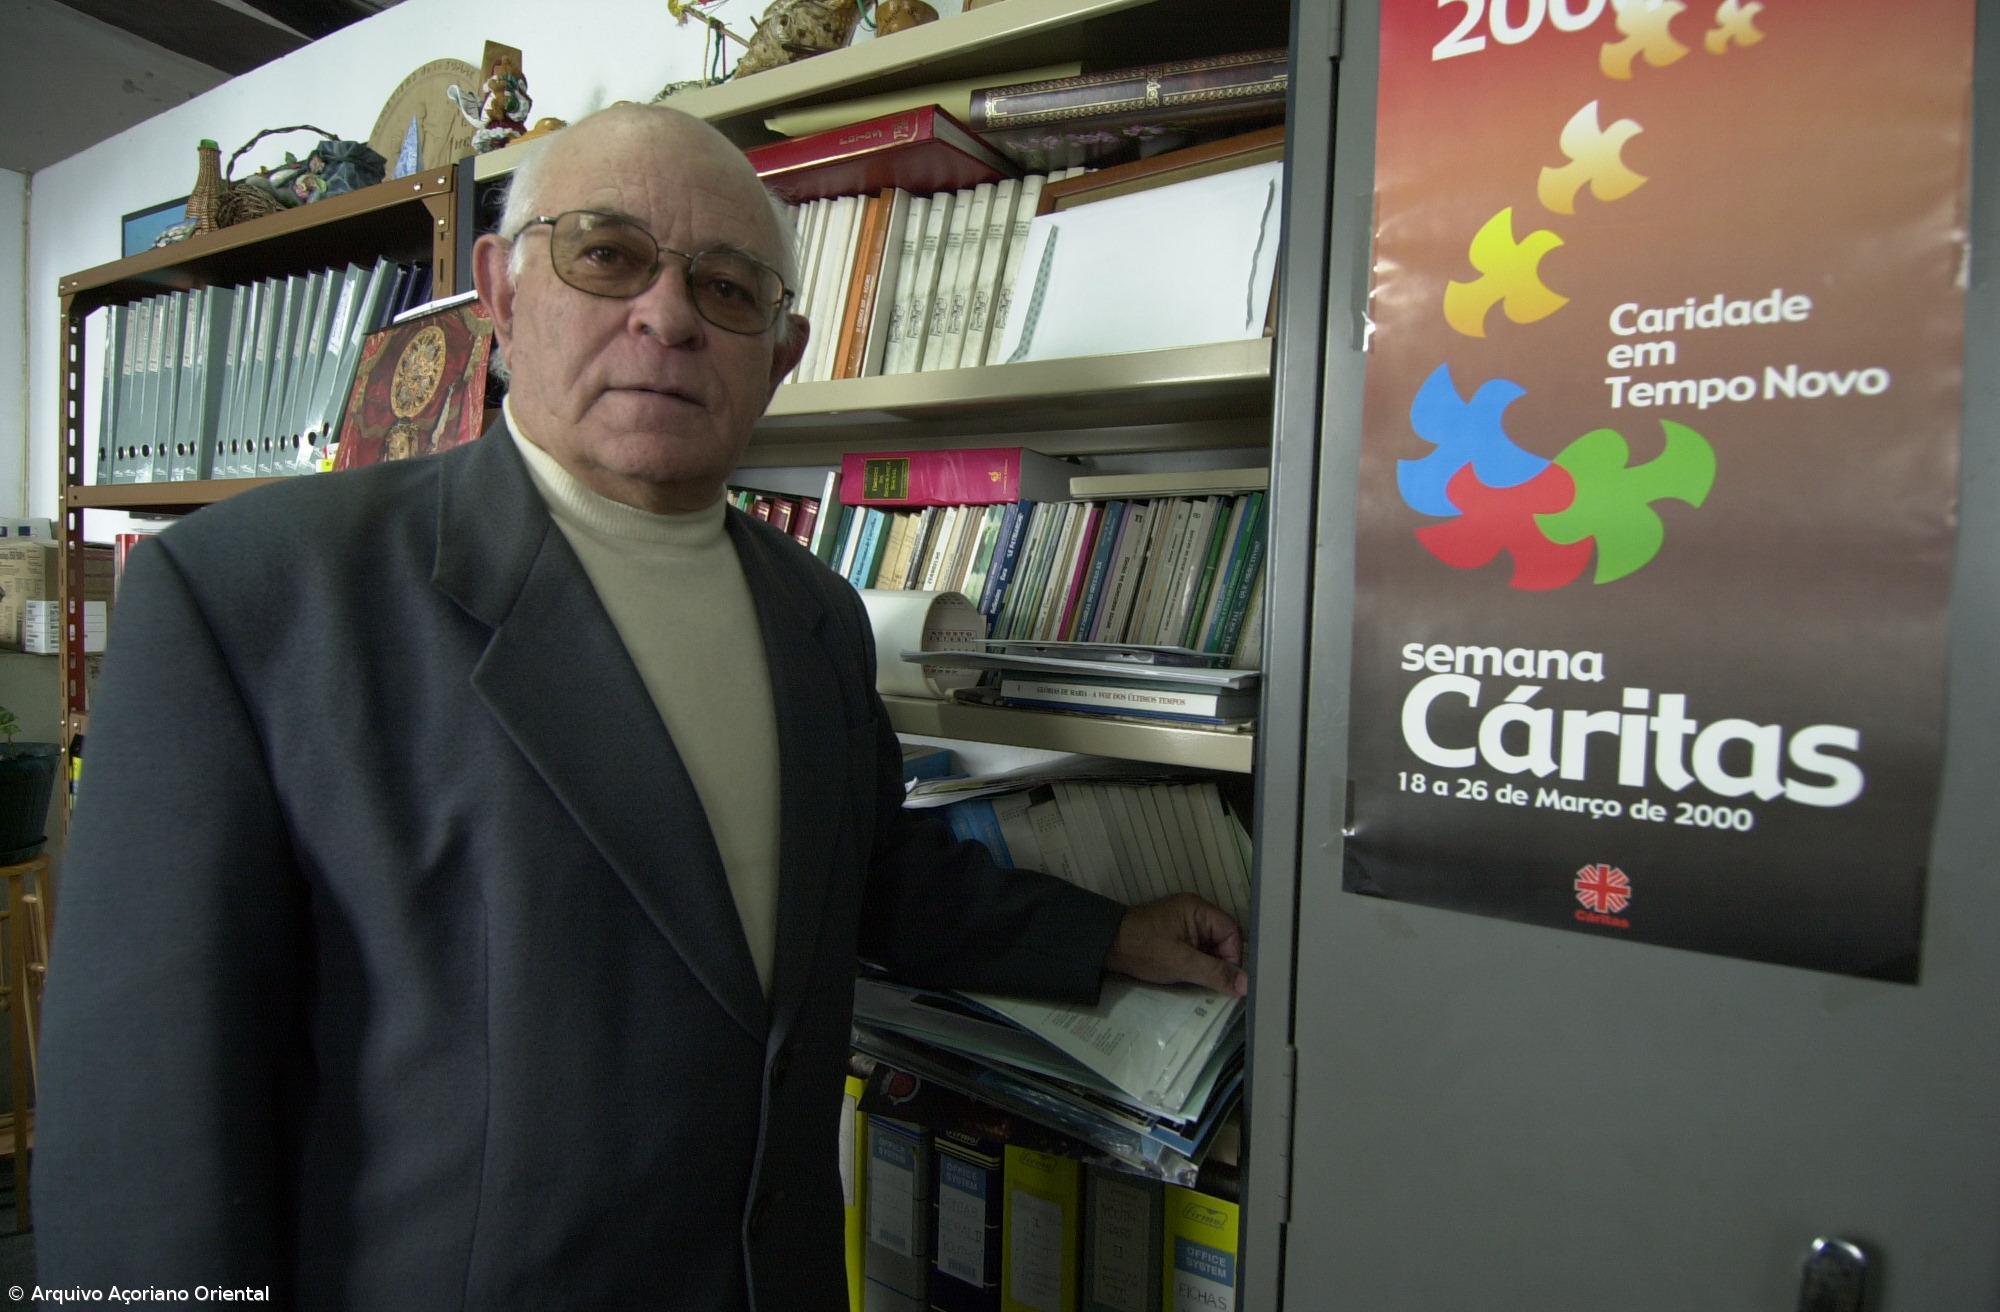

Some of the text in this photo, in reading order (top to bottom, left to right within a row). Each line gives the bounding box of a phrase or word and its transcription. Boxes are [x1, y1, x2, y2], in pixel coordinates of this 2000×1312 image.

[1608, 288, 1812, 336] Caridade
[1606, 340, 1676, 369] em
[1604, 364, 1890, 410] Tempo Novo
[1401, 642, 1604, 683] semana
[1401, 673, 1865, 808] Cáritas
[1399, 771, 1754, 832] 18 a 26 de Março de 2000
[1186, 1256, 1227, 1278] SYSTEM
[1187, 1246, 1227, 1267] OFFICE
